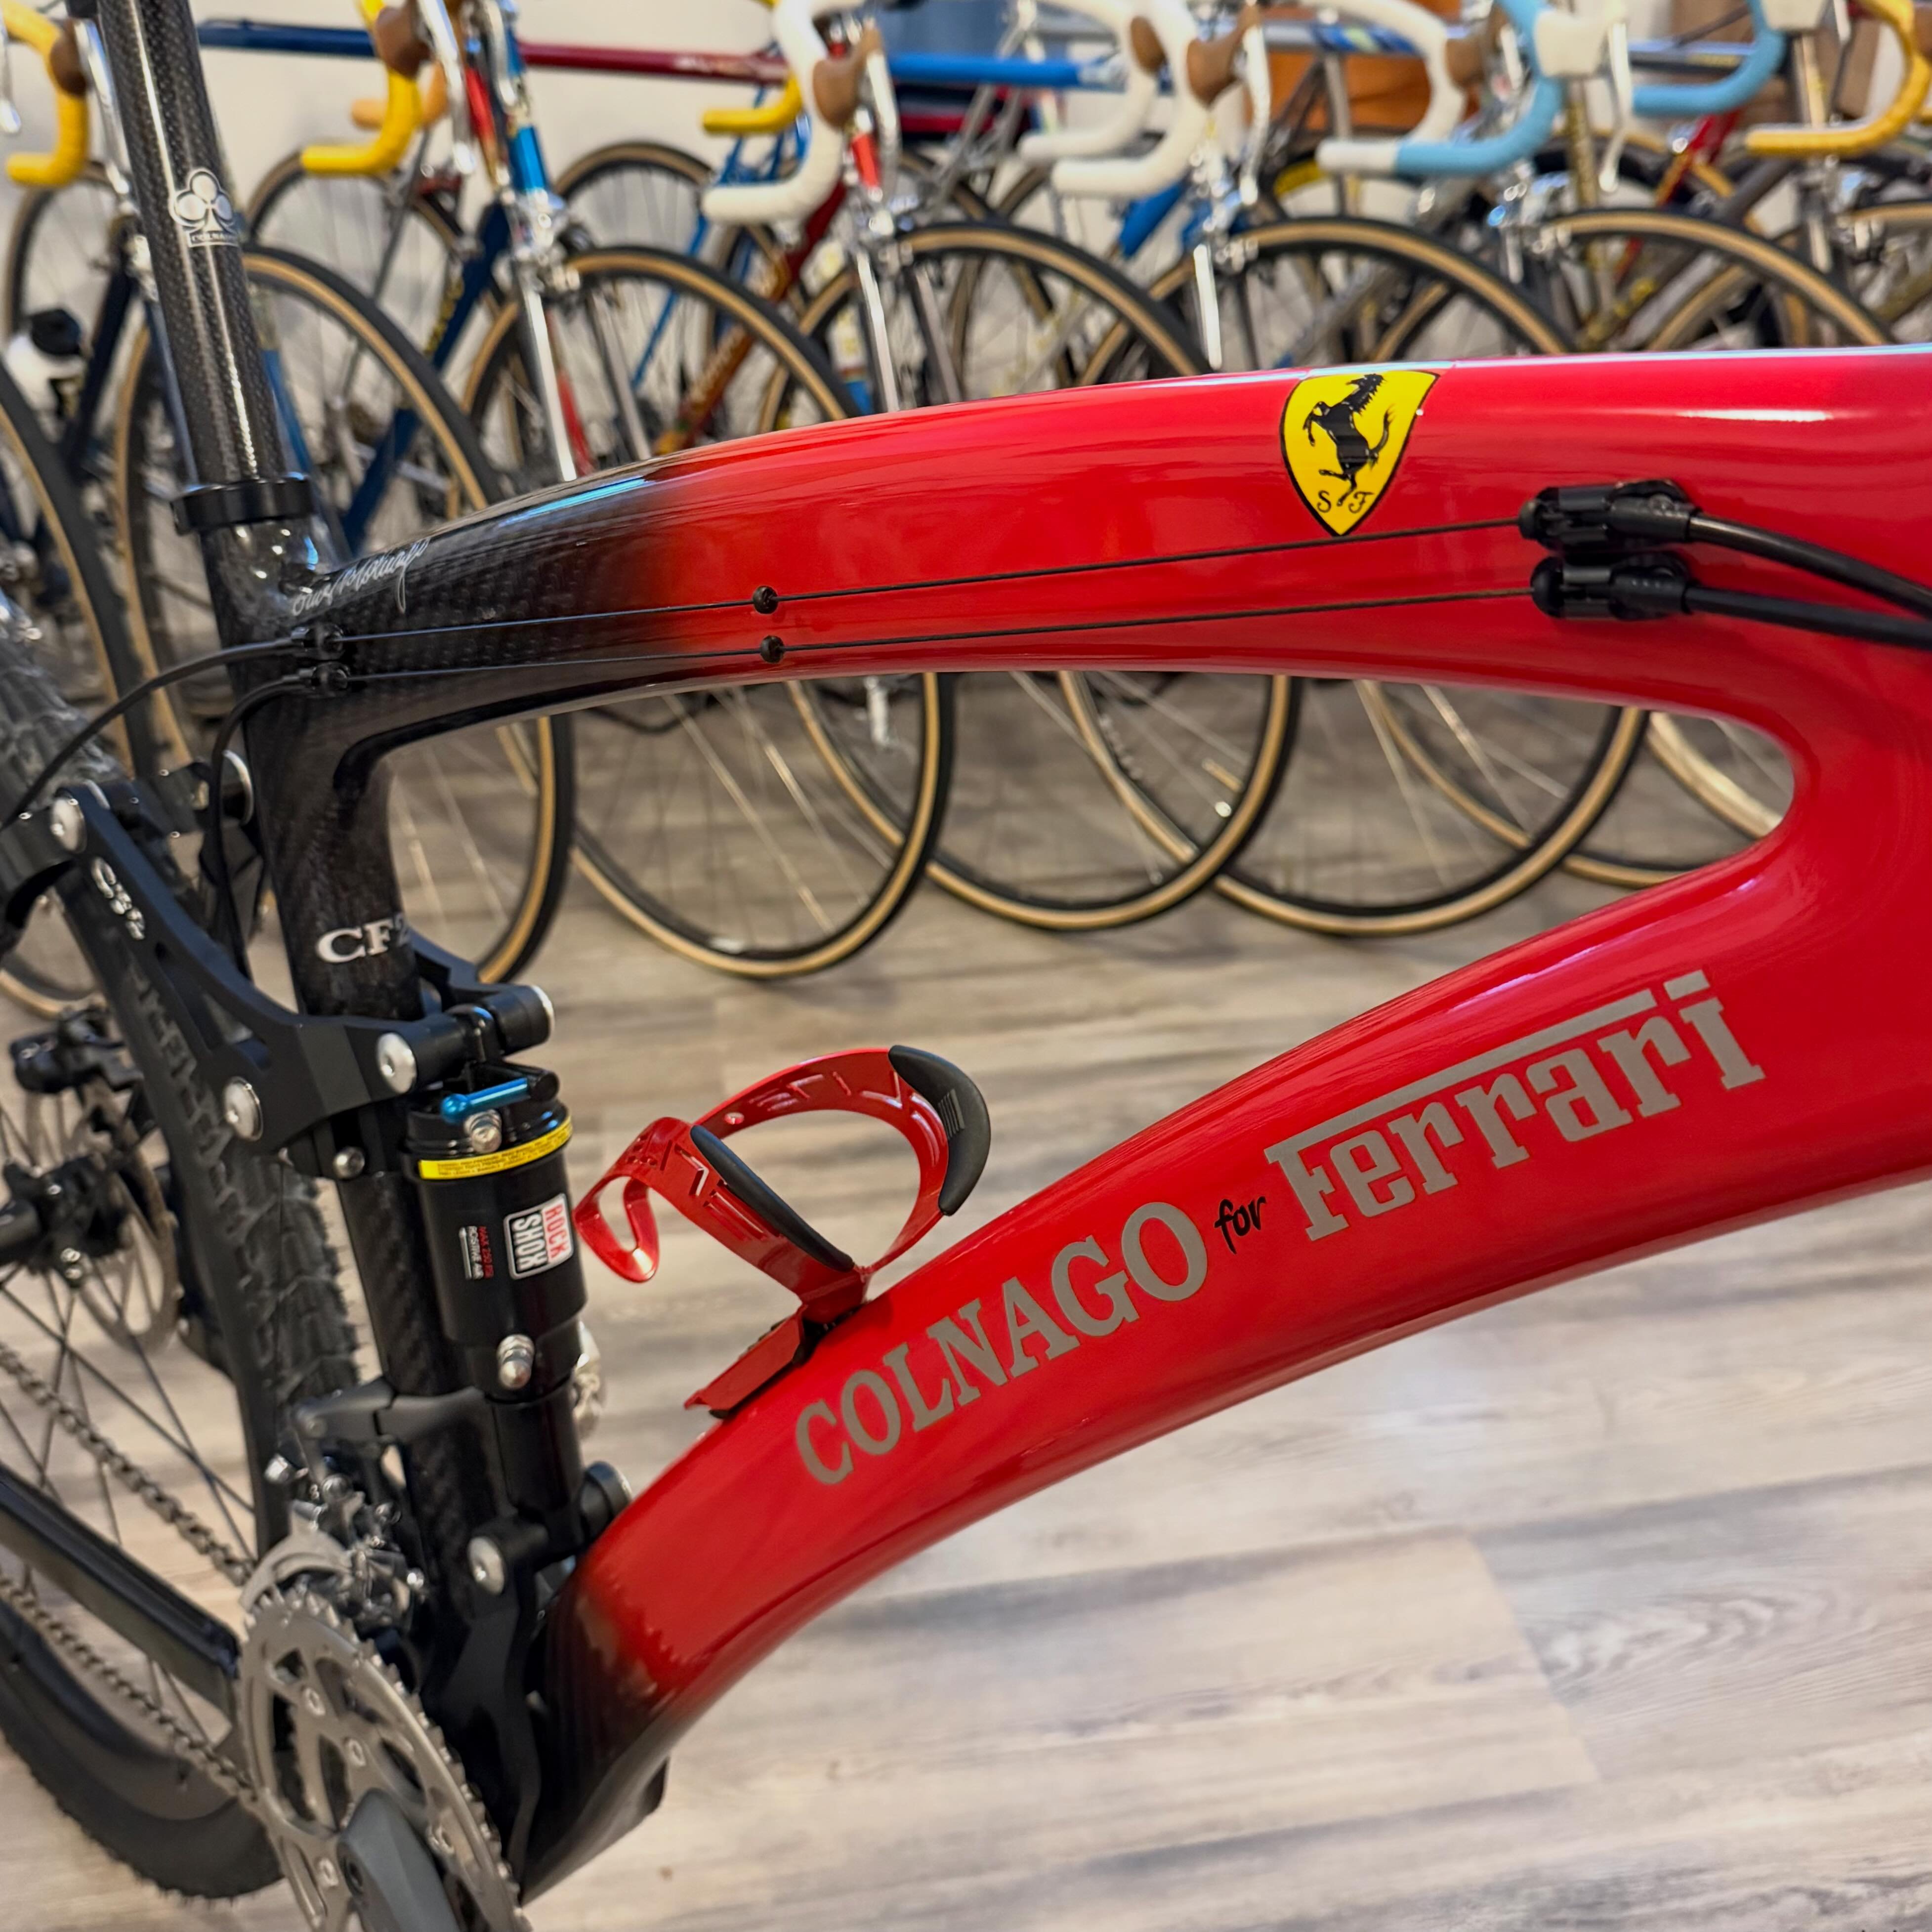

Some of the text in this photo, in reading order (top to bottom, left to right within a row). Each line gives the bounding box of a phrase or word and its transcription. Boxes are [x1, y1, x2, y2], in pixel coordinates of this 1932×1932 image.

[1317, 490, 1332, 513] S
[512, 1214, 548, 1270] SHOX
[545, 1204, 568, 1258] ROCK
[796, 970, 1764, 1484] COLNAGO for Ferrari
